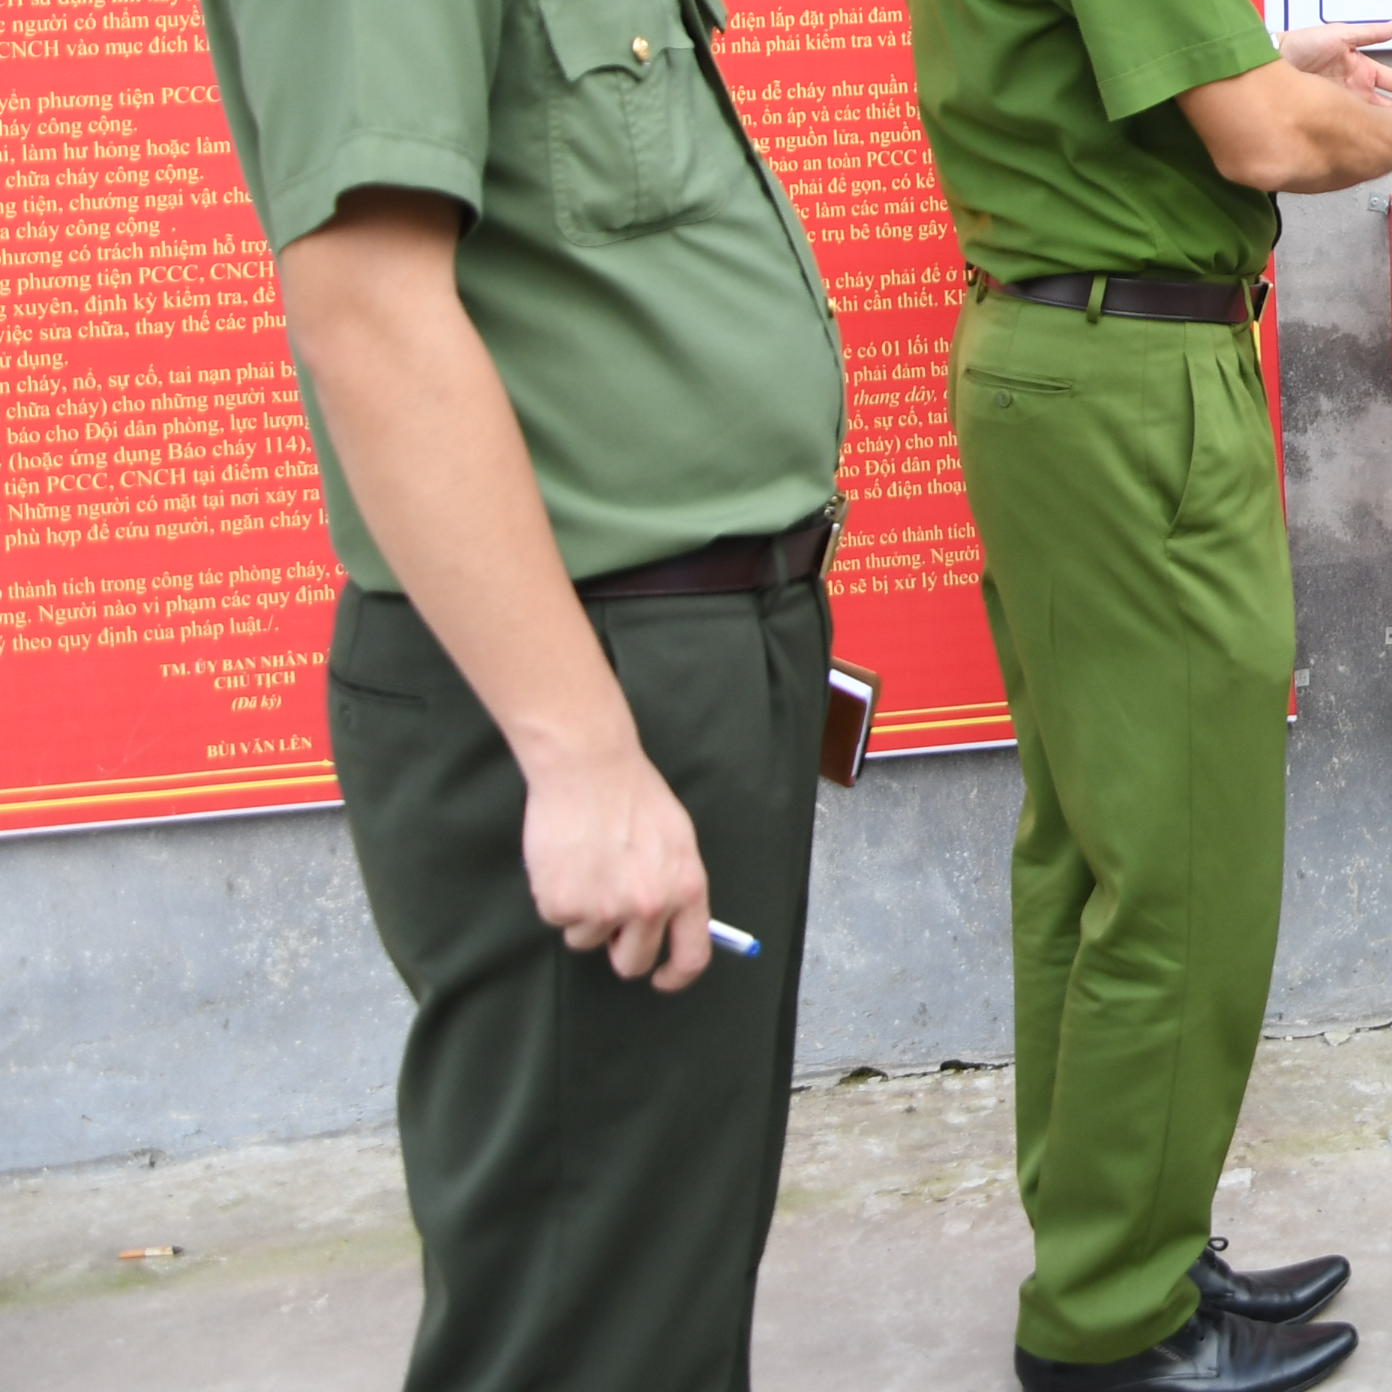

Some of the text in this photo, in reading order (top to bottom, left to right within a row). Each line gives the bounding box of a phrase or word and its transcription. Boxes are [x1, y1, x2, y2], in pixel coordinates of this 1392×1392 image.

[834, 104, 861, 121] các
[815, 196, 949, 218] làm các mái che
[68, 244, 92, 263] có
[96, 241, 144, 261] trách
[149, 239, 208, 260] nhiệm
[856, 341, 878, 359] có
[881, 340, 900, 357] 01
[108, 374, 131, 391] sự
[168, 366, 192, 385] tai
[197, 368, 232, 385] nạn
[8, 502, 72, 523] Những
[77, 496, 131, 521] người
[135, 494, 159, 513] có
[202, 490, 225, 511] tại
[230, 487, 260, 507] nơi
[879, 522, 976, 545] có thành tích
[38, 600, 97, 626] Người
[142, 596, 160, 614] vi
[165, 594, 217, 618] phạm
[220, 590, 251, 609] các
[256, 592, 290, 610] quy
[279, 733, 313, 752] LÊN
